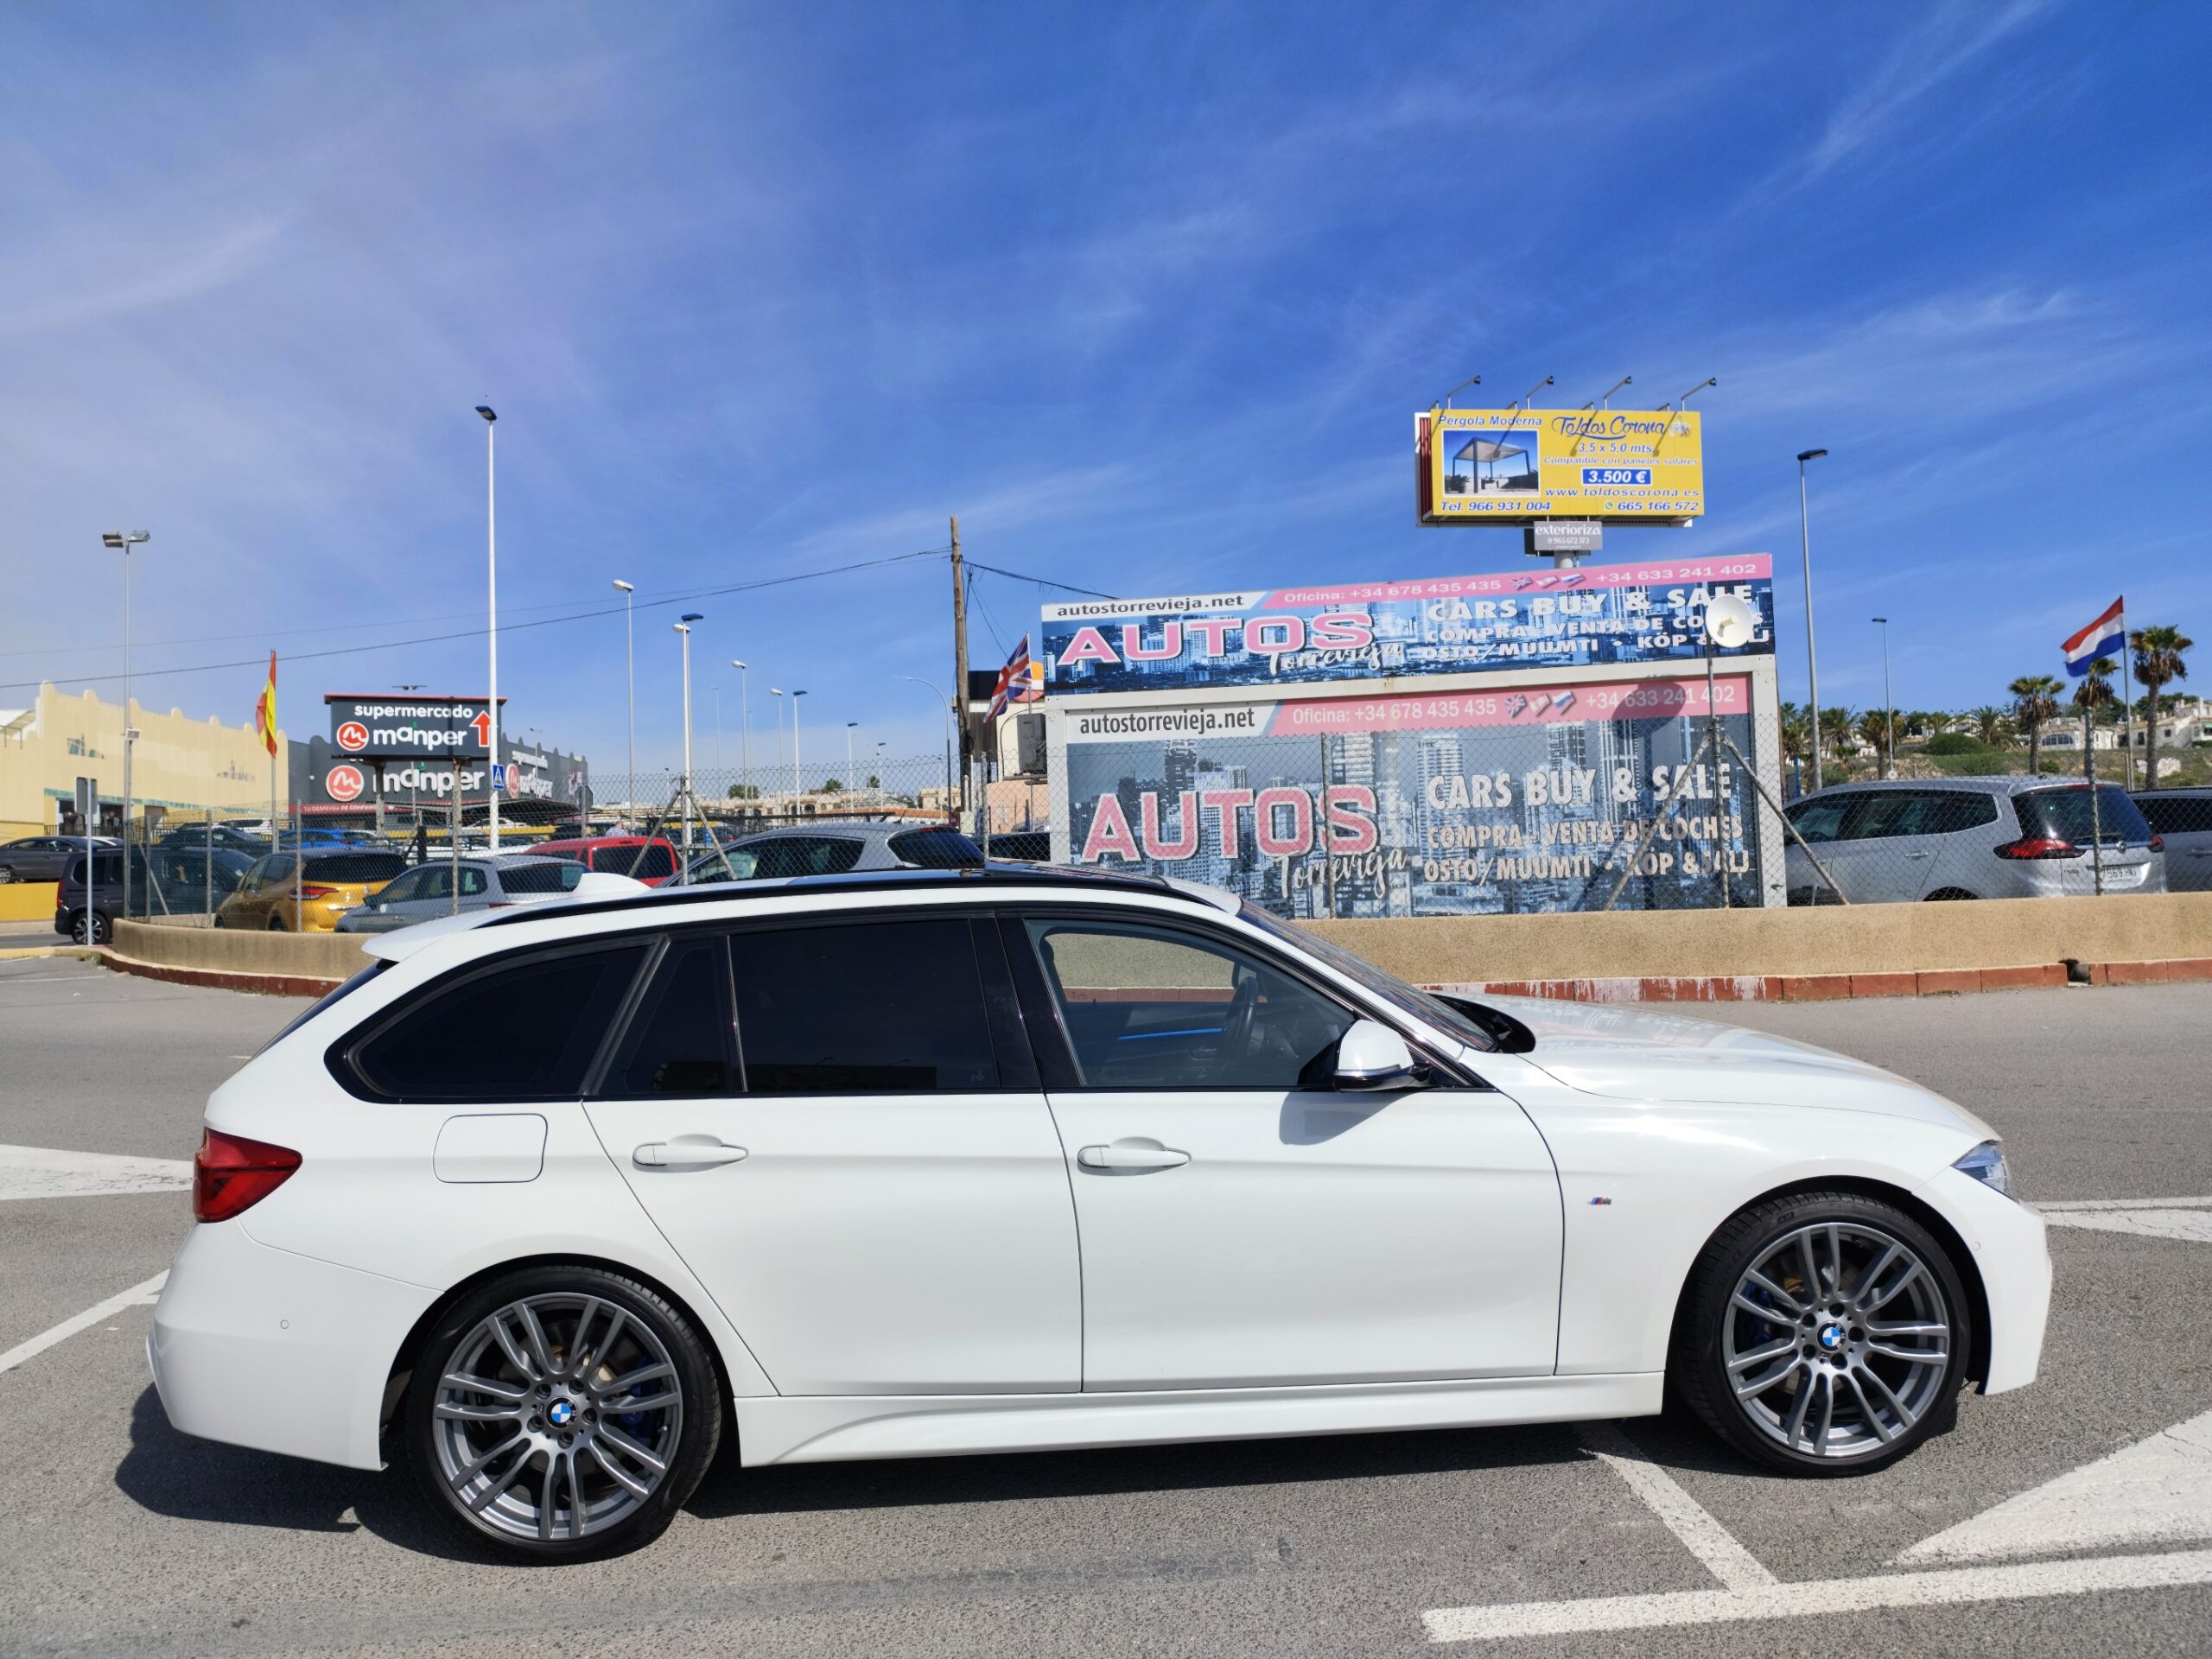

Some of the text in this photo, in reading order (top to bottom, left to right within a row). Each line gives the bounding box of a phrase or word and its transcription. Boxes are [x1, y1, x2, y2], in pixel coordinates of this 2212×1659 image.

[1490, 415, 1542, 425] Moderna
[1551, 416, 1665, 437] Toldos Corona
[1544, 456, 1599, 465] Compatible
[1588, 470, 1632, 483] 3.500
[1469, 501, 1494, 511] 966
[1497, 501, 1521, 511] 931
[1526, 501, 1550, 511] 004
[1618, 501, 1700, 511] 665 166 572
[1535, 524, 1601, 535] exterioriza
[1597, 564, 1756, 582] +34 633 241 402
[1284, 581, 1501, 603] Oficina: +34 678 435 435
[1058, 594, 1243, 616] autostorrevieja.net
[1427, 599, 1518, 621] CARS
[1534, 594, 1607, 615] BUY
[1624, 592, 1651, 611] &
[1427, 613, 1763, 642] COMPRA VENTA DE COS
[1057, 612, 1376, 667] AUTOS
[1638, 632, 1687, 648] KÖP
[1264, 641, 1404, 676] Torrevieja
[1586, 685, 1735, 709] +34 633 241 402
[354, 704, 474, 720] supermercado
[1080, 708, 1255, 734] autostorrevieja.net
[1293, 699, 1497, 724] Oficina: +34 678 435 435
[373, 727, 467, 751] manper
[1427, 763, 1732, 810] CARS BUY & SALE
[1081, 784, 1379, 864] AUTOS
[1427, 823, 1523, 849] COMPRA
[1543, 820, 1615, 845] VENTA
[1624, 820, 1650, 842] DE
[1659, 816, 1743, 841] COCHES
[1682, 851, 1700, 874] &
